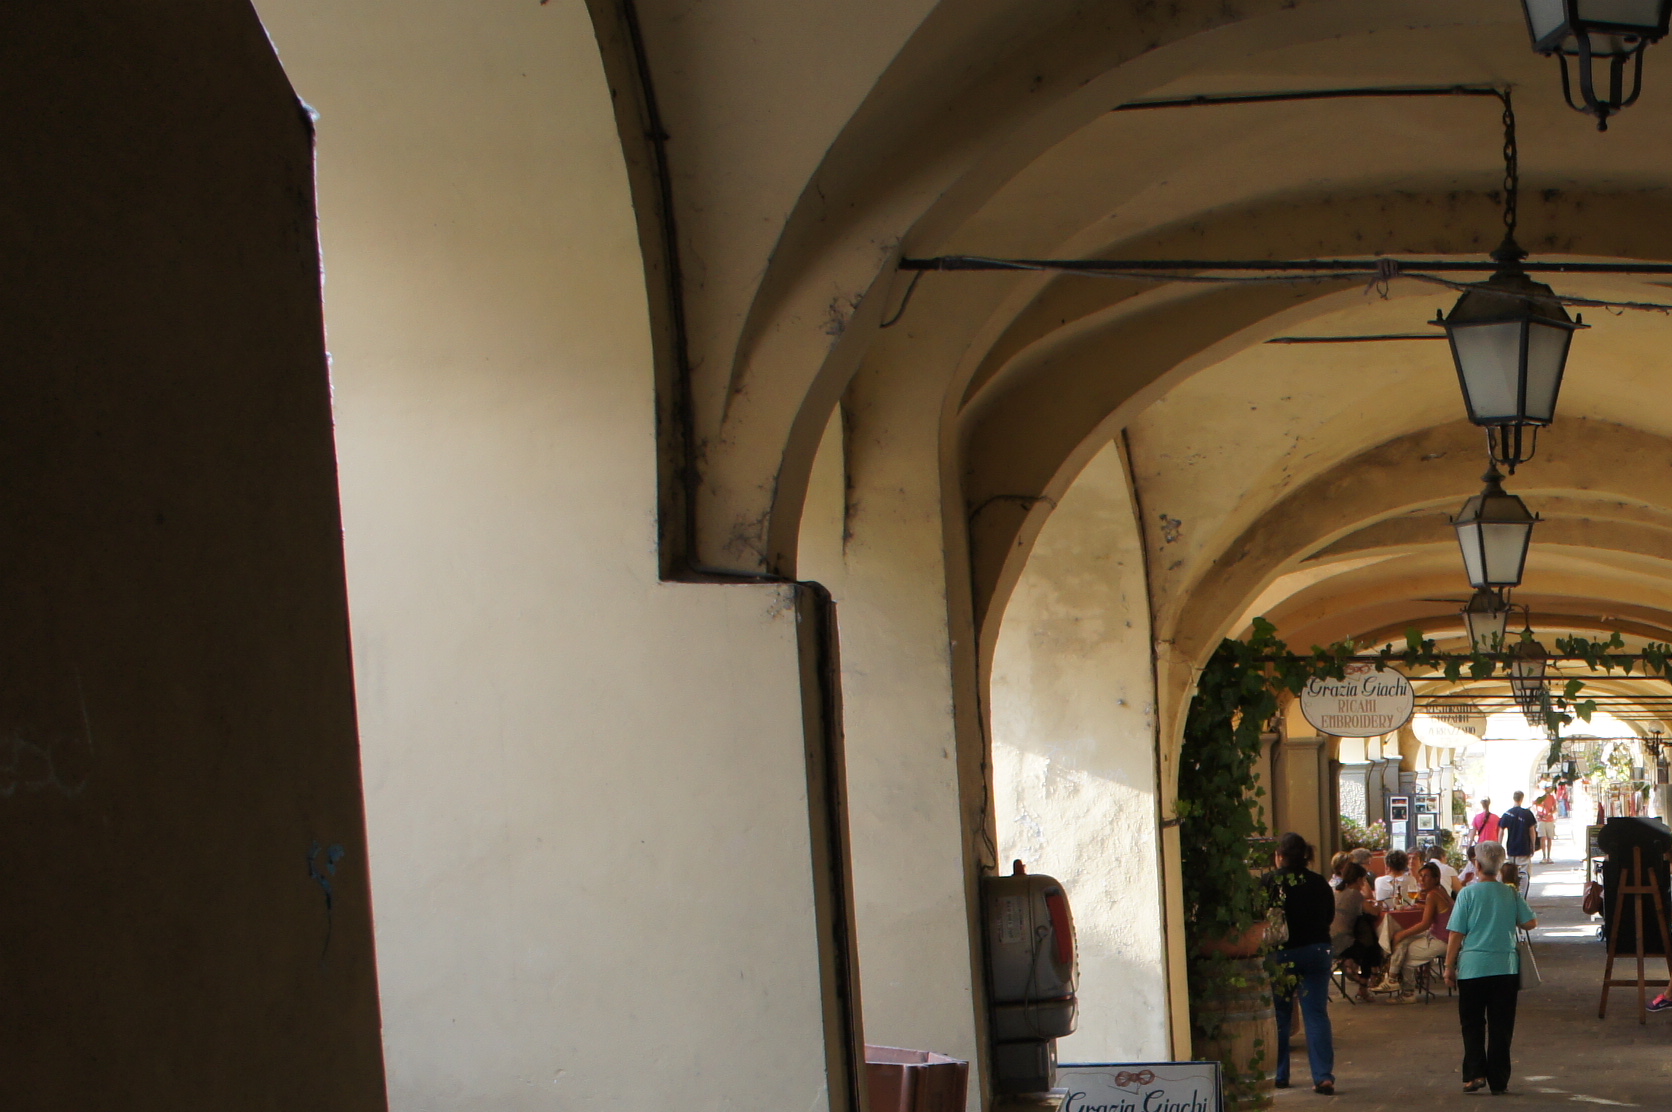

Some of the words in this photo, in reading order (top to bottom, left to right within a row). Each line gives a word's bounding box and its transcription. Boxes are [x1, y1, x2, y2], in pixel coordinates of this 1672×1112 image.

[1308, 677, 1357, 697] Grazia
[1361, 676, 1408, 697] Giachi
[1338, 699, 1377, 713] RICAMI
[1321, 714, 1394, 729] EMBROIDERY
